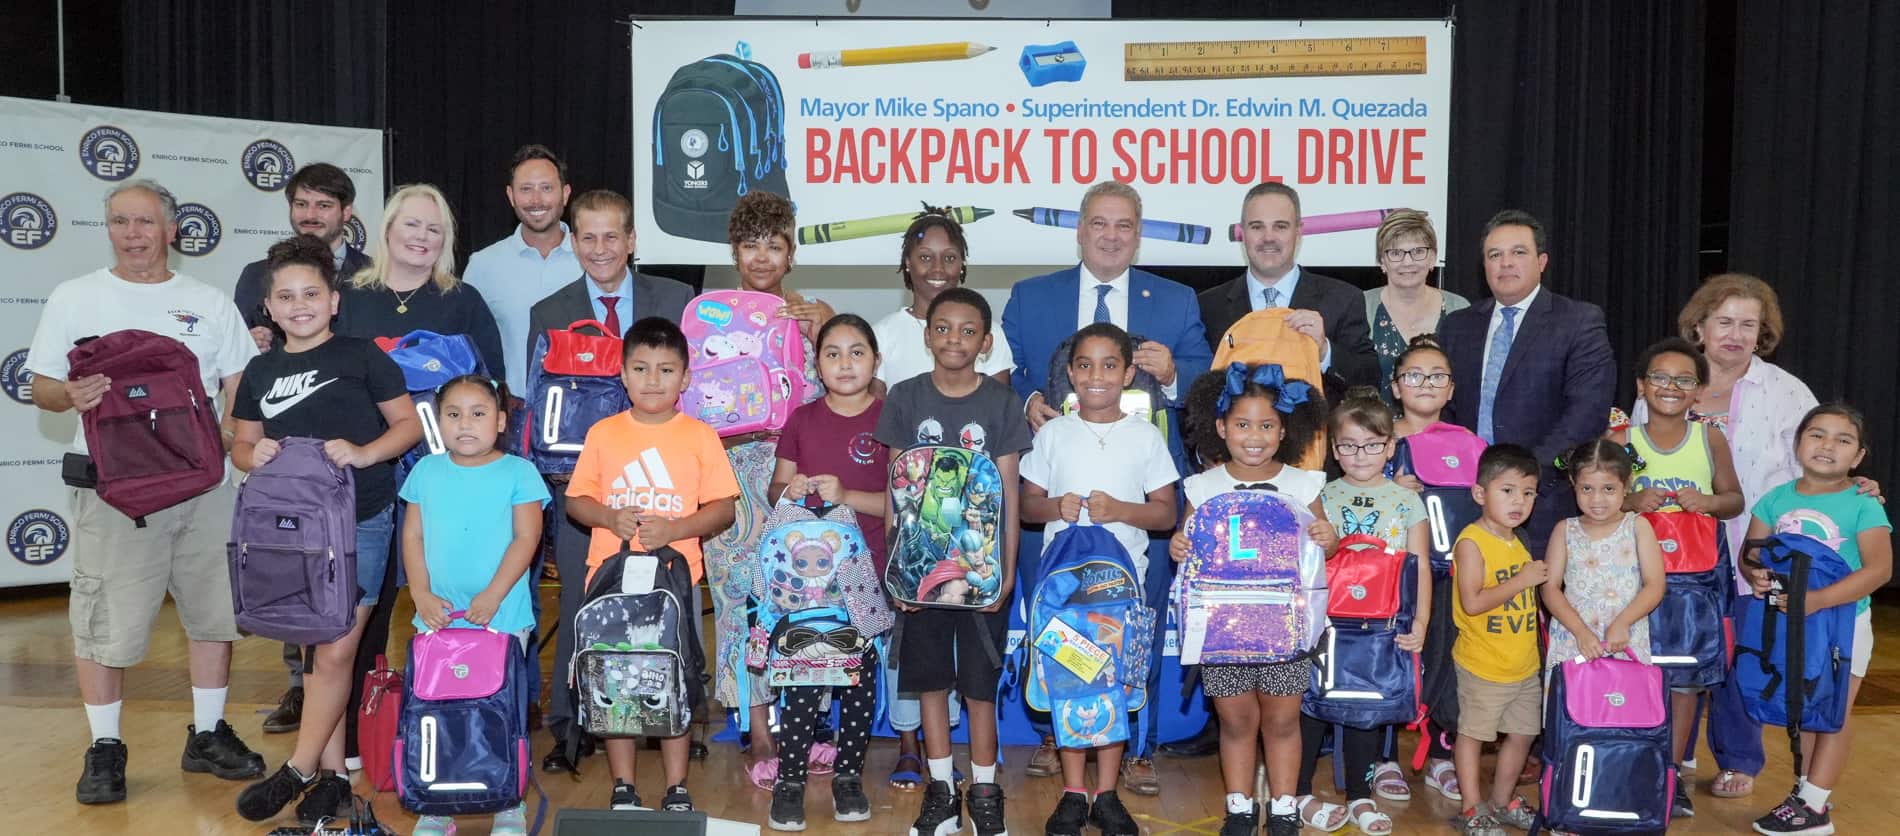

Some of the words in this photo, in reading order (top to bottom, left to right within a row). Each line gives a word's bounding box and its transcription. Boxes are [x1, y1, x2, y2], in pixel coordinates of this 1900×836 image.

[800, 96, 871, 122] Mayor
[874, 95, 930, 118] Mike
[934, 97, 1001, 123] Spano
[1021, 96, 1187, 123] Superintendent
[1190, 96, 1221, 118] Dr.
[1225, 95, 1295, 118] Edwin
[1298, 97, 1327, 118] M.
[1330, 95, 1429, 122] Quezada
[9, 141, 33, 149] FERMI
[34, 143, 65, 152] SCHOOL
[151, 153, 178, 161] ENRICO
[178, 155, 201, 163] FERMI
[200, 157, 229, 165] SCHOOL
[806, 128, 1030, 184] BACKPACK
[1043, 128, 1098, 184] TO
[1112, 128, 1283, 185] SCHOOL
[1298, 128, 1426, 185] DRIVE
[97, 161, 126, 176] EF
[256, 173, 282, 188] EF
[11, 229, 42, 245] EF
[180, 238, 209, 252] EF
[266, 369, 320, 400] NIKE
[606, 486, 684, 513] adidas
[1351, 495, 1375, 508] BE
[1228, 514, 1258, 561] L
[24, 544, 55, 561] EF
